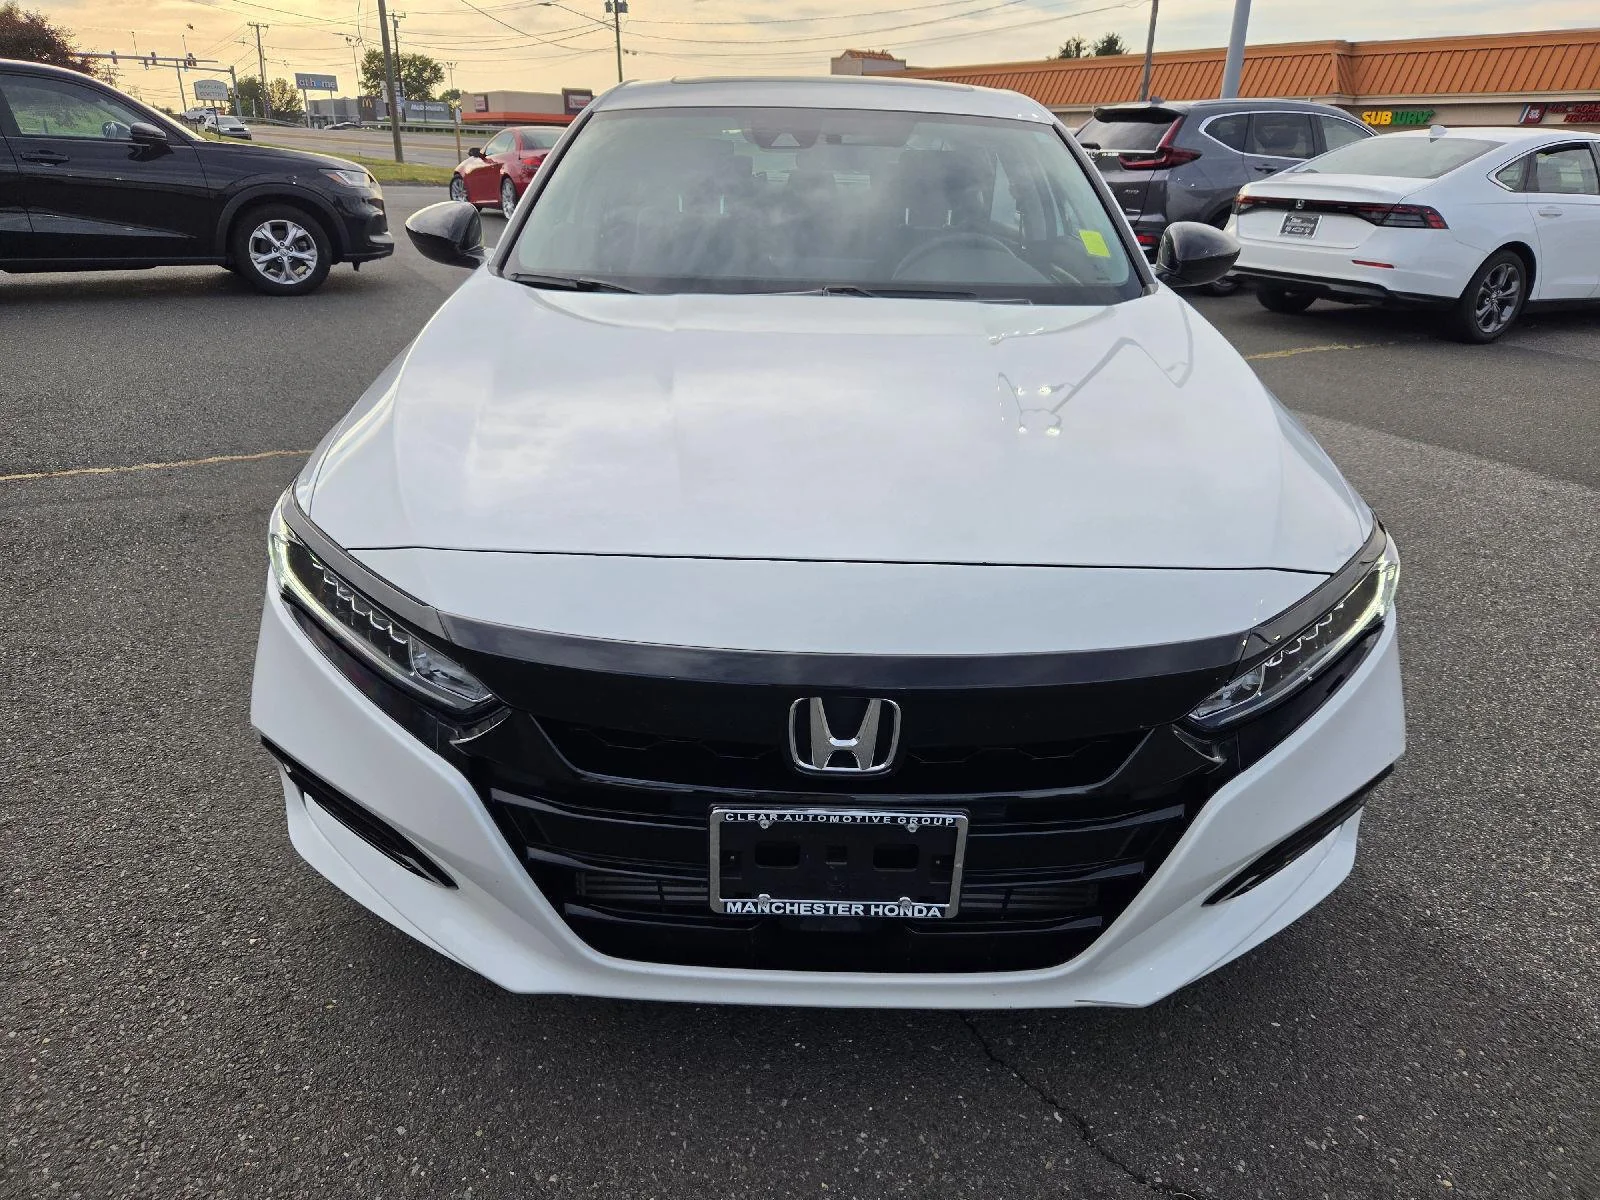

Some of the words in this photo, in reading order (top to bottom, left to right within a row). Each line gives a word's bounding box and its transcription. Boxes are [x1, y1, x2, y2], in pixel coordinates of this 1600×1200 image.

[1361, 109, 1435, 125] SUBWAY
[725, 813, 778, 821] CLEAR
[783, 814, 891, 824] AUTOMOTIVE
[897, 816, 954, 826] GROUP
[726, 900, 864, 916] MANCHESTER
[870, 903, 942, 918] HONDA
